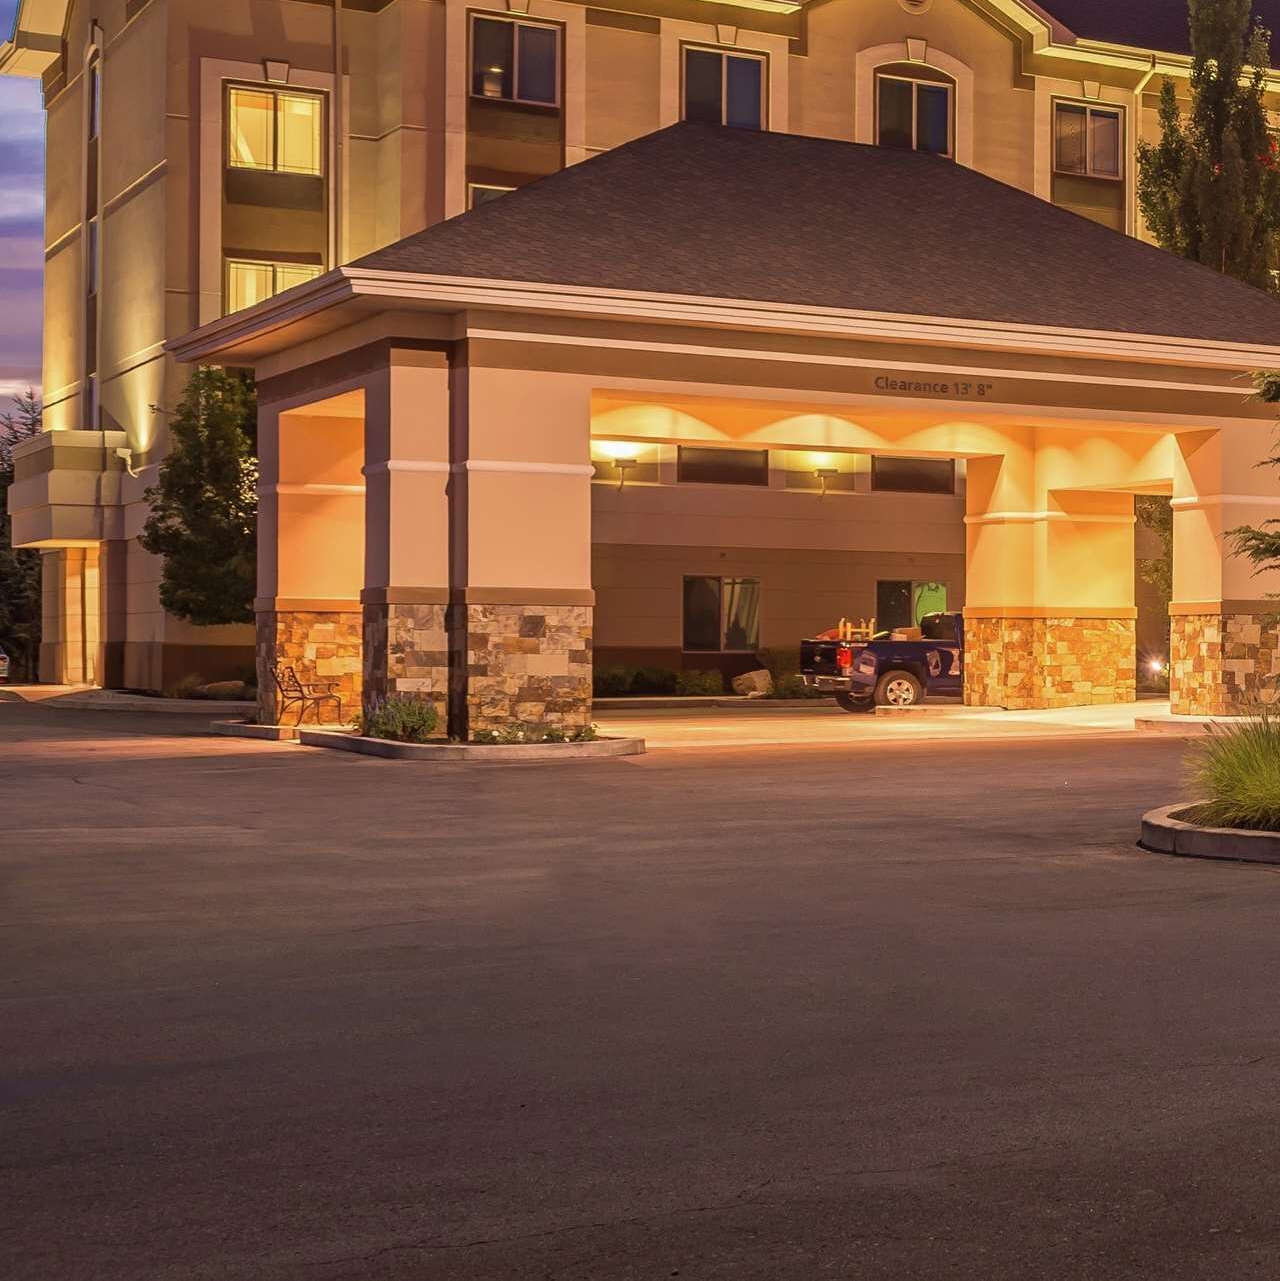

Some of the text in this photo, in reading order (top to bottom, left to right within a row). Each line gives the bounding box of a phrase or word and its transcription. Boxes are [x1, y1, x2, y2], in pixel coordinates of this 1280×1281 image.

[874, 376, 993, 396] Clearance 13' 8"
